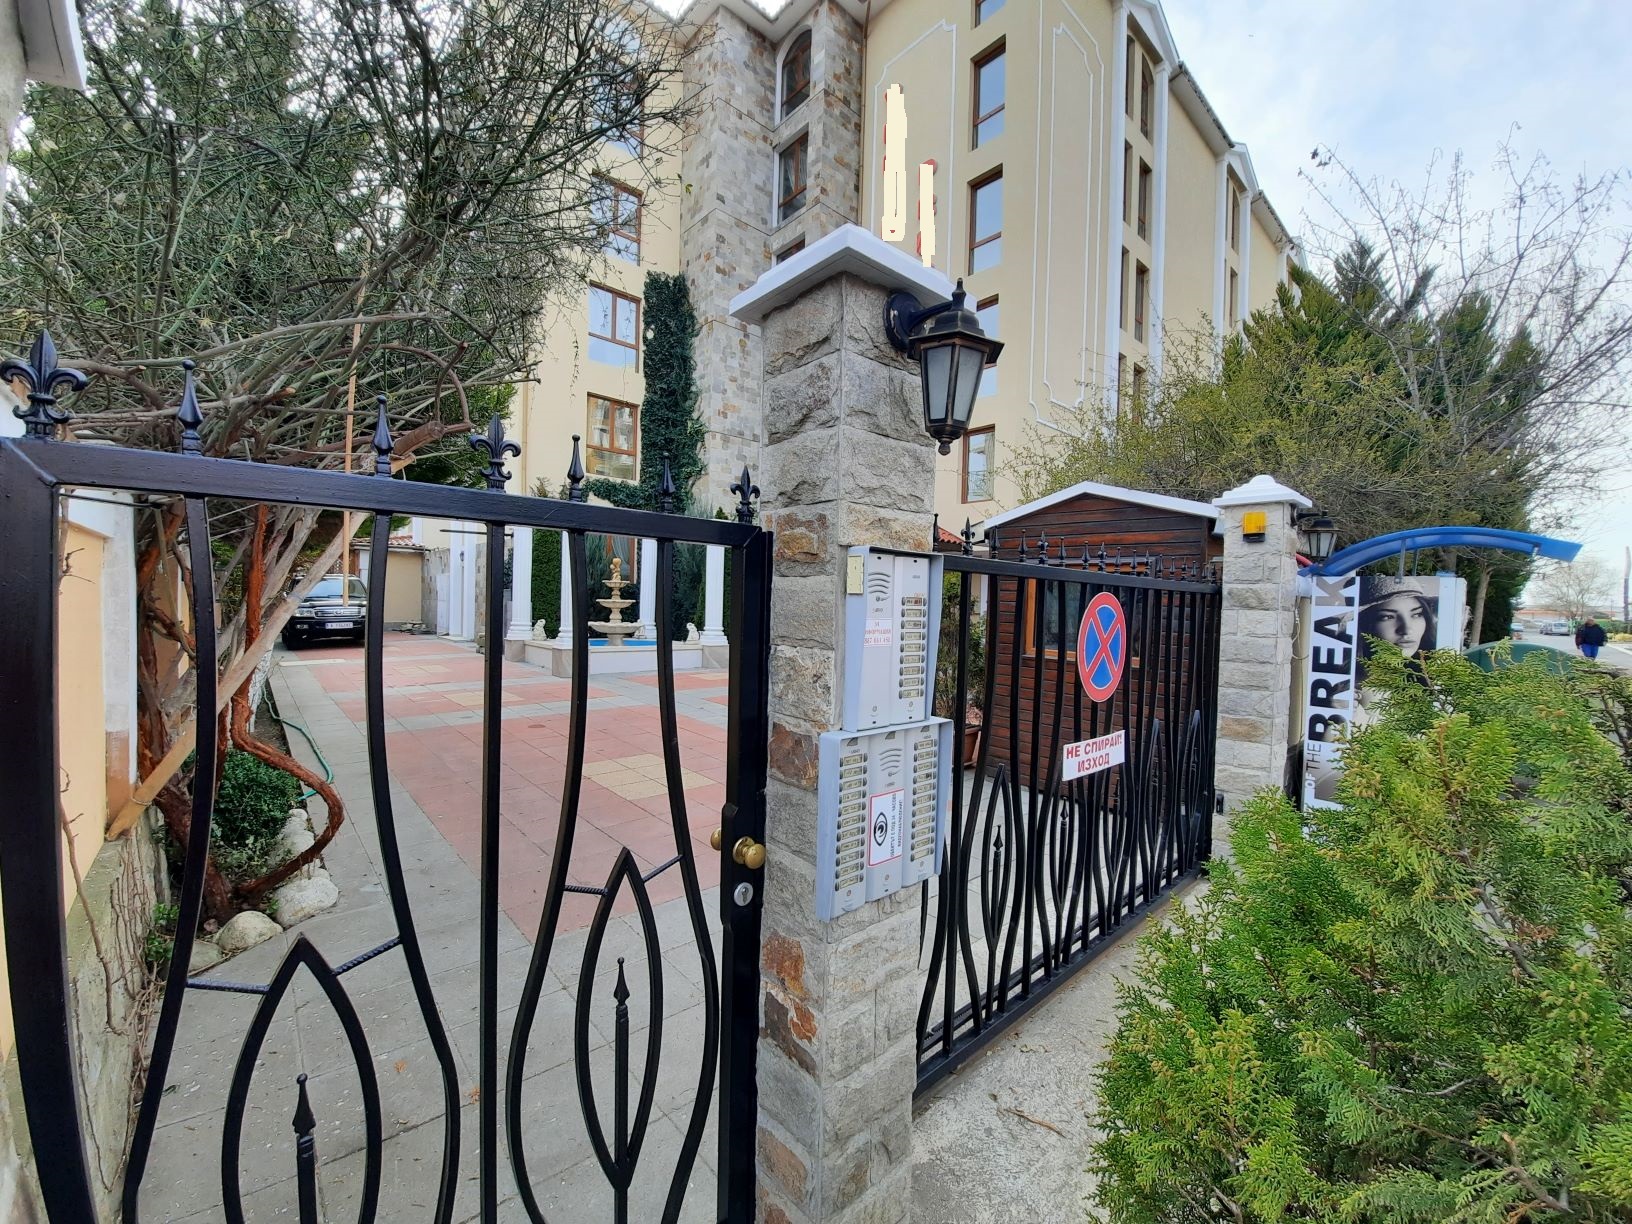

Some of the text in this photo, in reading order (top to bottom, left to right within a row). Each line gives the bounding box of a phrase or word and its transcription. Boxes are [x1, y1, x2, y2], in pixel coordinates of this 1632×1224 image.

[1305, 575, 1356, 788] OF THE BREAK
[1066, 746, 1081, 759] НЕ
[1078, 753, 1110, 773] ИЗХОД
